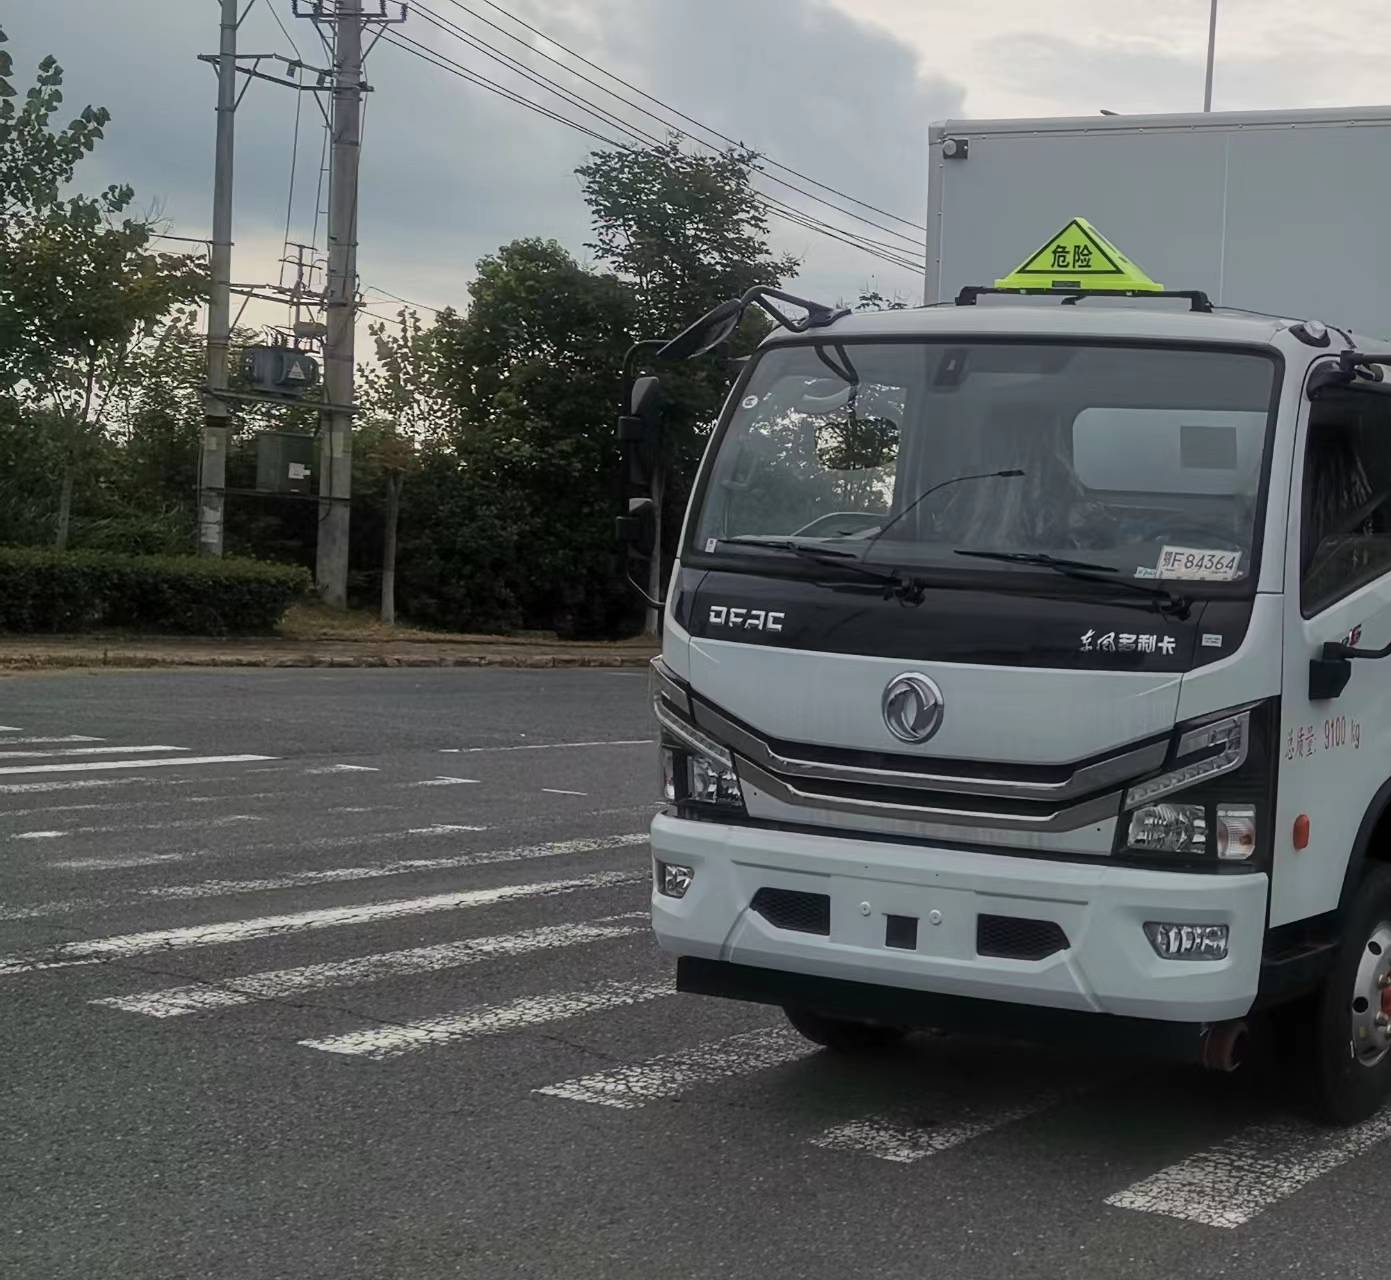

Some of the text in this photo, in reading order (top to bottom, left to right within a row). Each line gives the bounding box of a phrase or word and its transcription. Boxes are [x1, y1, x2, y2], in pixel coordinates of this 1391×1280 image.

[1051, 244, 1093, 269] 危险
[709, 605, 785, 632] DFAC
[1079, 629, 1176, 655] 东风多利卡
